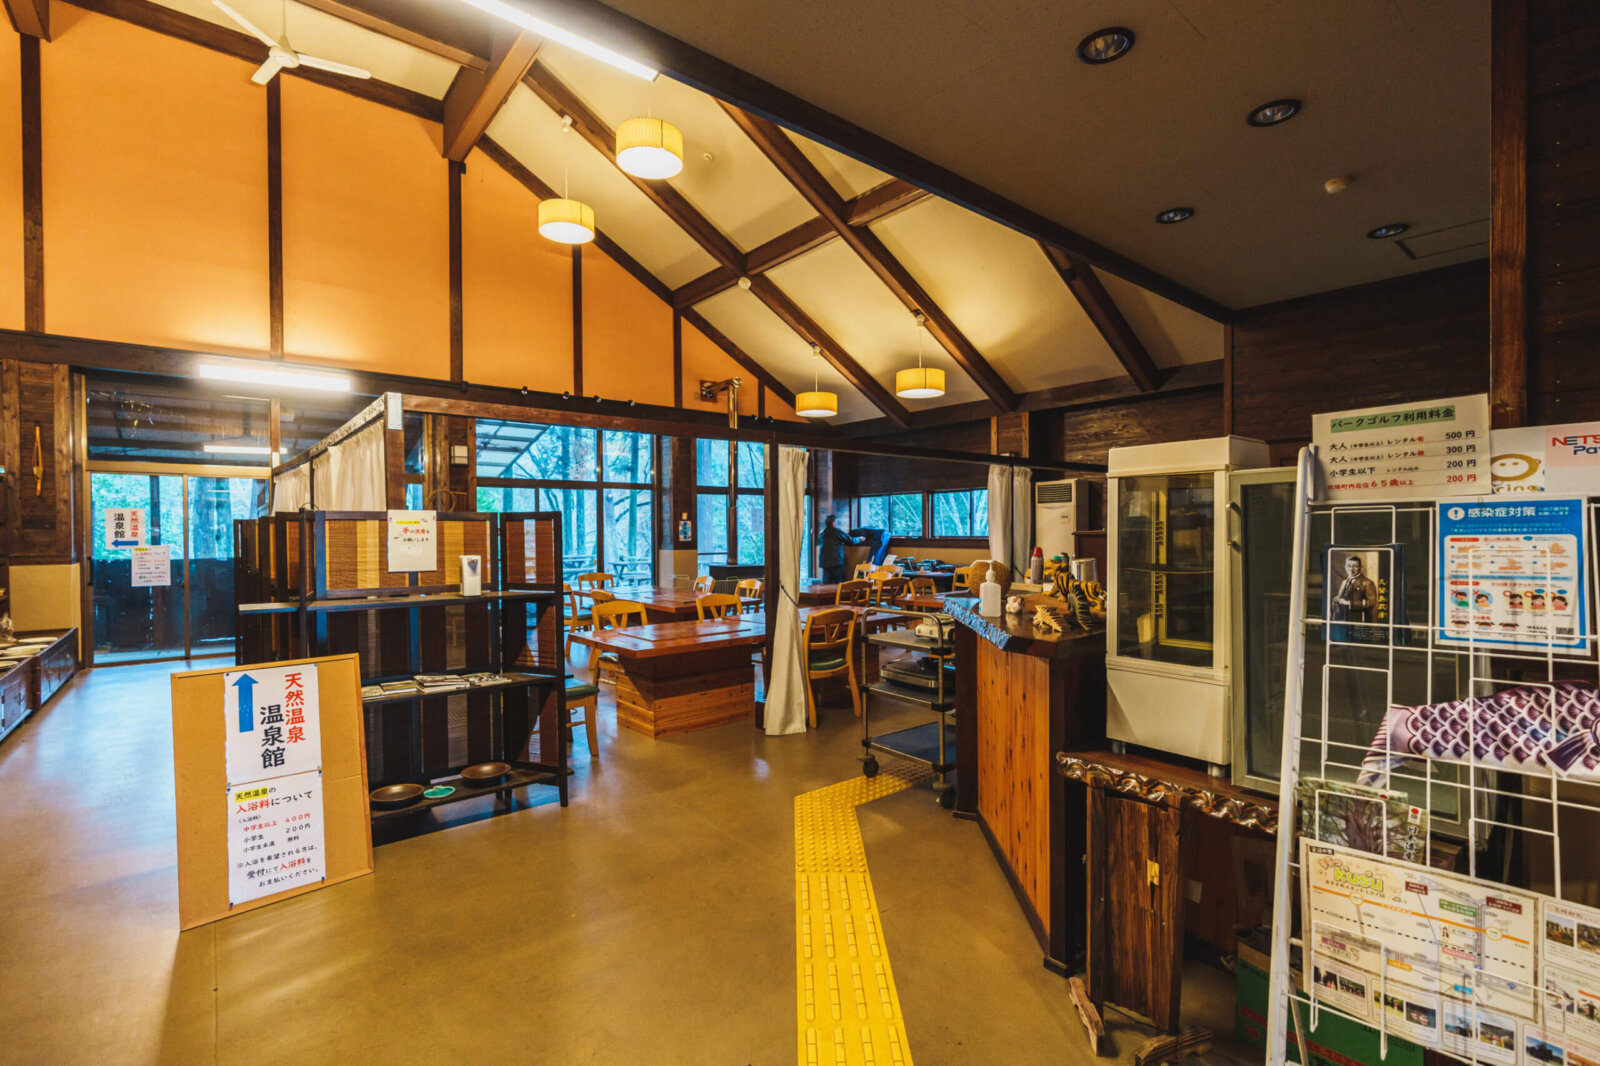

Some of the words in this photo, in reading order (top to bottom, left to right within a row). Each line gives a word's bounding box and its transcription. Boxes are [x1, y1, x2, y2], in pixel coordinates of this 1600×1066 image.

[1332, 408, 1455, 429] パークゴルフ利用料金
[1329, 442, 1347, 451] 大人
[1445, 432, 1462, 440] 500
[1465, 430, 1475, 438] 円
[1329, 455, 1347, 464] 大人
[1446, 446, 1463, 454] 300
[1466, 444, 1476, 452] 円
[1329, 467, 1376, 478] 小学生以下
[1446, 461, 1463, 469] 200
[1466, 459, 1477, 467] 円
[1447, 475, 1464, 483] 200
[1466, 473, 1477, 482] 円
[1468, 506, 1536, 518] 感染症対策
[114, 513, 125, 538] 温泉館
[131, 511, 139, 538] 天然温泉
[284, 672, 306, 744] 天然温泉
[260, 704, 286, 769] 温泉館
[235, 787, 277, 801] 天然温泉の
[236, 790, 313, 814] 入浴料について
[243, 820, 277, 832] 中学生以上
[243, 834, 264, 843] 小学生
[243, 841, 275, 853] 小学生未満
[1334, 866, 1383, 892] kusu
